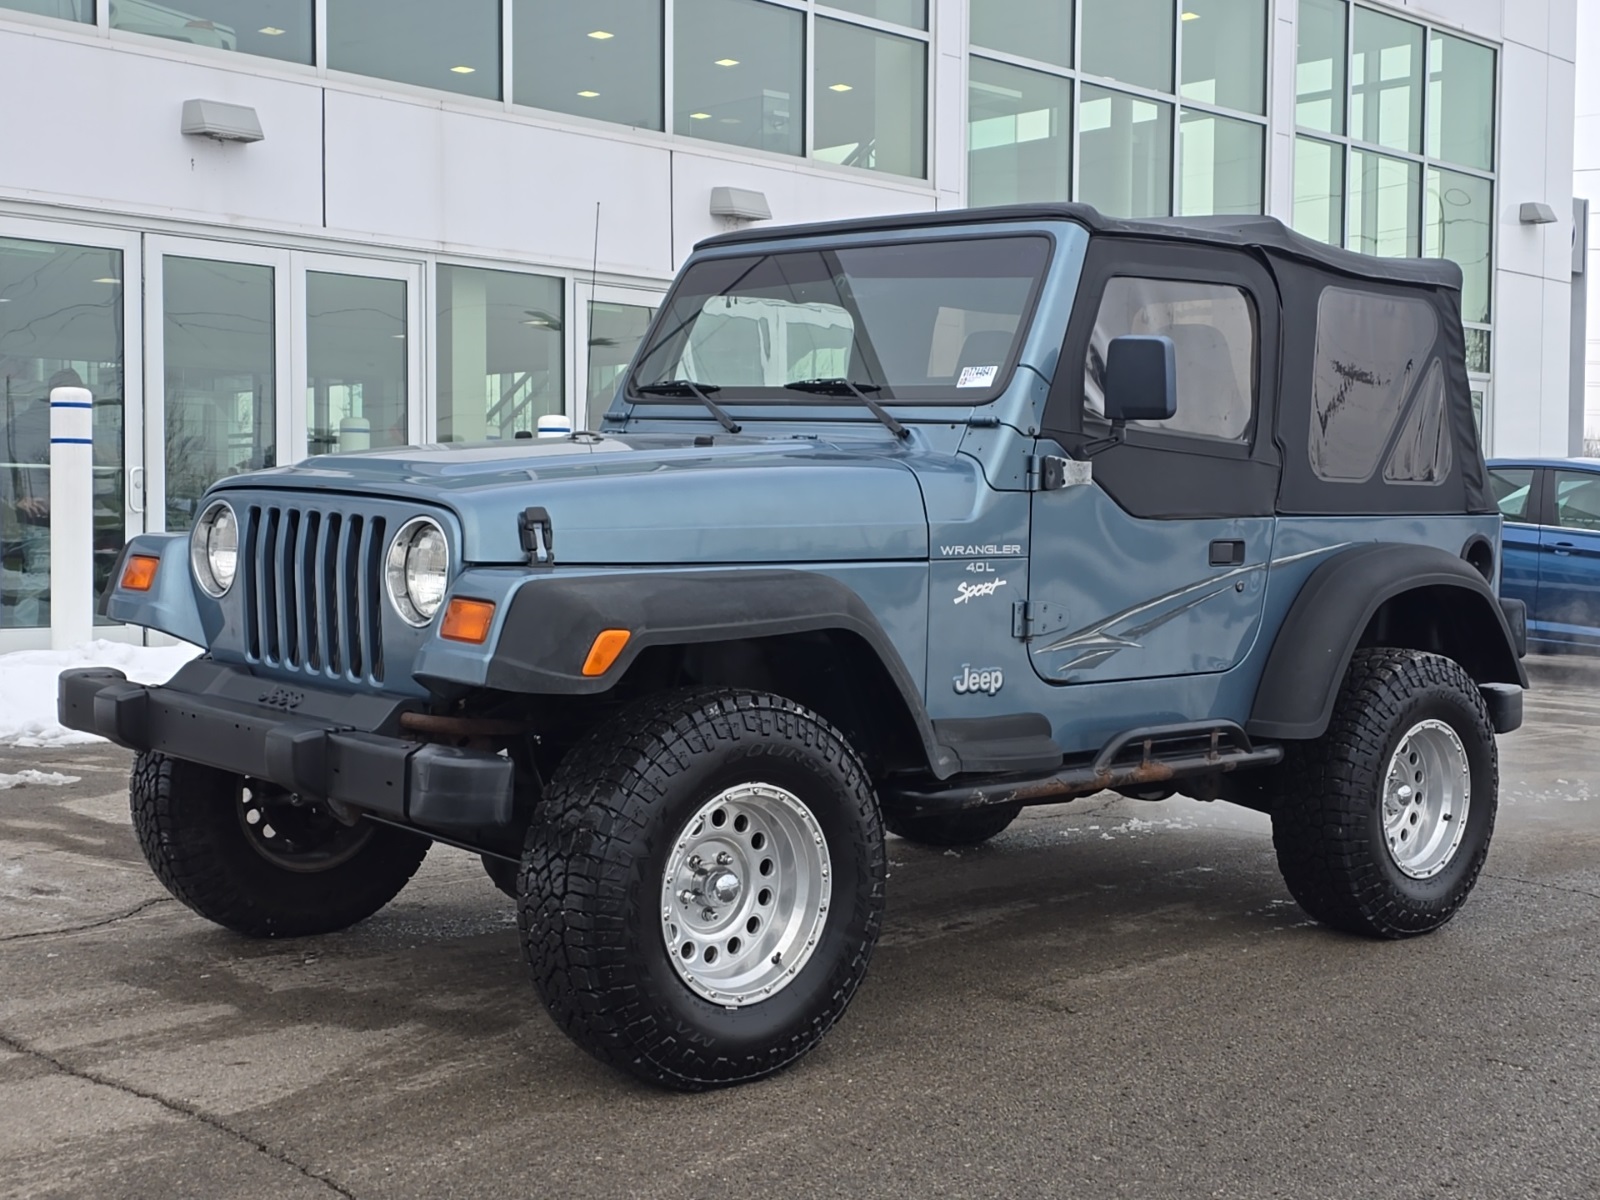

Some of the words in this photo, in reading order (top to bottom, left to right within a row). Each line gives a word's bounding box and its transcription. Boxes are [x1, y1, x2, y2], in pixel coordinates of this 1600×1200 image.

[940, 544, 1021, 555] WRANGLER
[953, 577, 1007, 605] Sport
[953, 663, 1003, 695] Jeep
